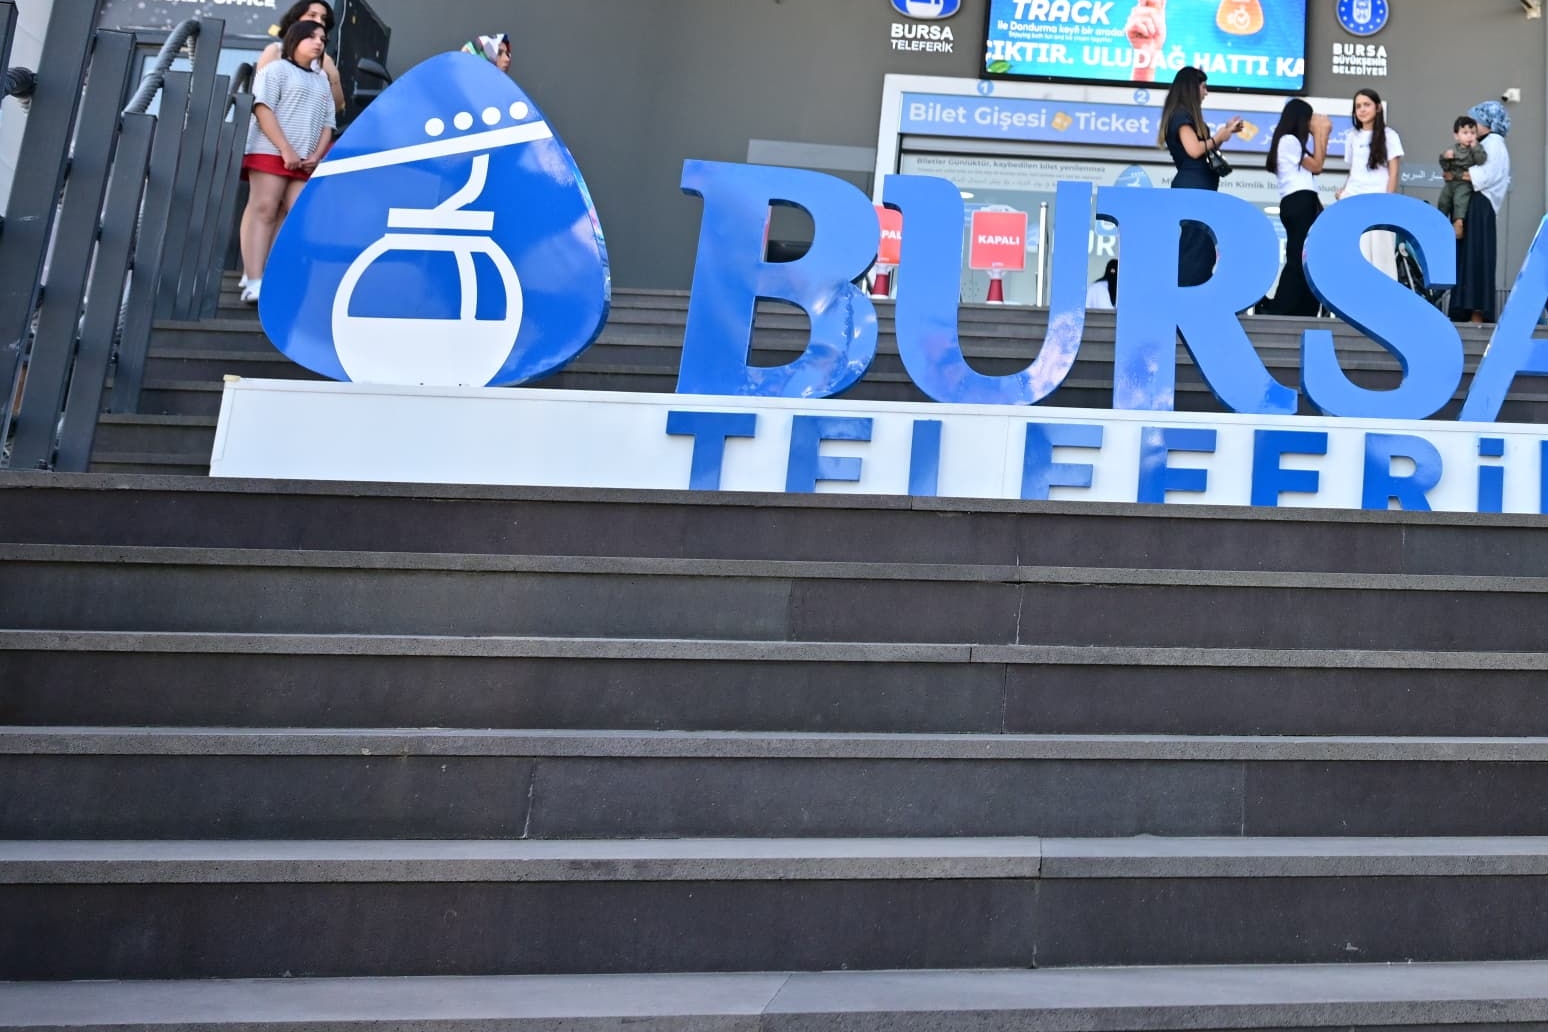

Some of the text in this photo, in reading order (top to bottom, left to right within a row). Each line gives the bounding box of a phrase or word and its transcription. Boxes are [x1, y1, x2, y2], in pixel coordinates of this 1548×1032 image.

[890, 23, 954, 41] BURSA
[1010, 21, 1058, 33] Dondurma
[1332, 42, 1388, 58] BURSA
[1082, 44, 1186, 70] ULUDAĞ
[1194, 50, 1269, 76] HATTI
[909, 102, 967, 124] Bilet
[973, 106, 1047, 131] Gişesi
[1075, 111, 1150, 134] Ticket
[977, 233, 1021, 246] KAPALI
